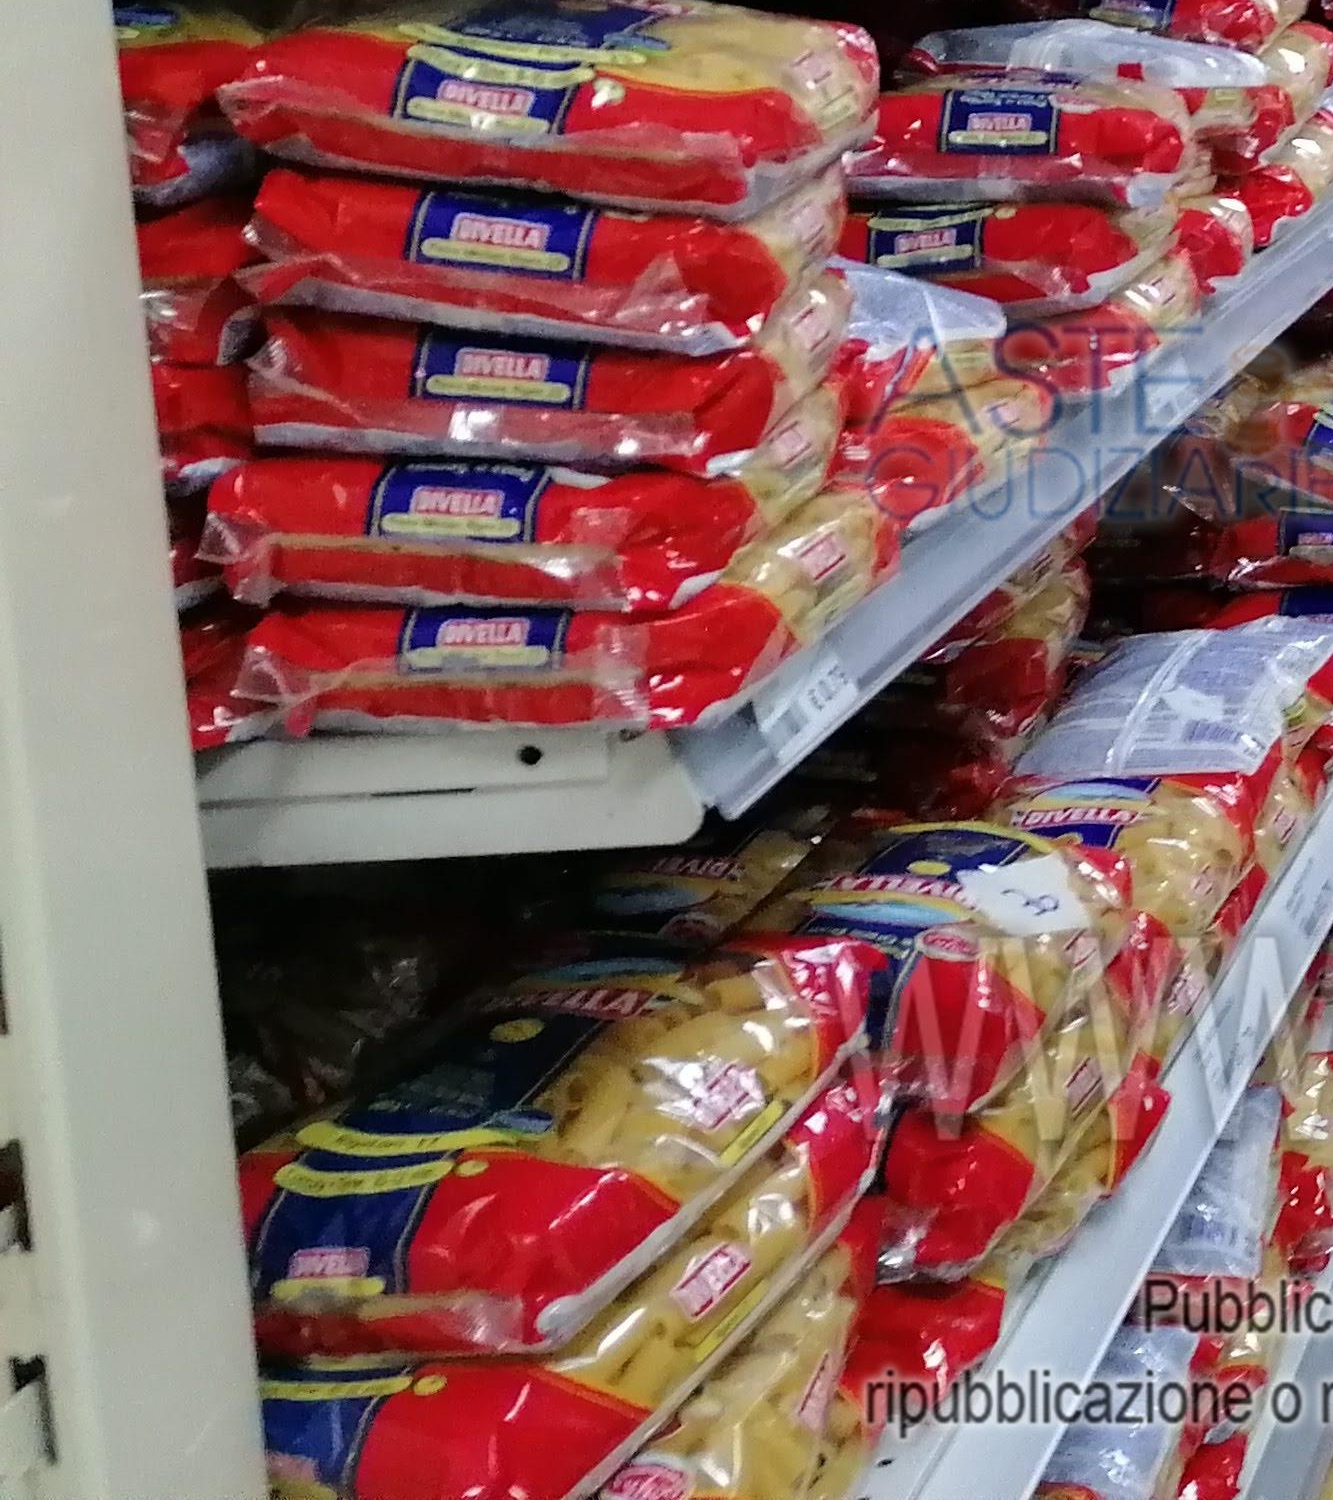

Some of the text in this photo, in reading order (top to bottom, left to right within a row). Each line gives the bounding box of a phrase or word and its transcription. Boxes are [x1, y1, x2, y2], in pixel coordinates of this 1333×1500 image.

[442, 84, 529, 113] DIVELLA
[458, 216, 545, 248] DIVELLA
[460, 351, 545, 380] DIVELLA
[415, 489, 500, 516] DIVELLA
[442, 620, 524, 646] DIVELLA
[1024, 806, 1140, 827] DIVELLA
